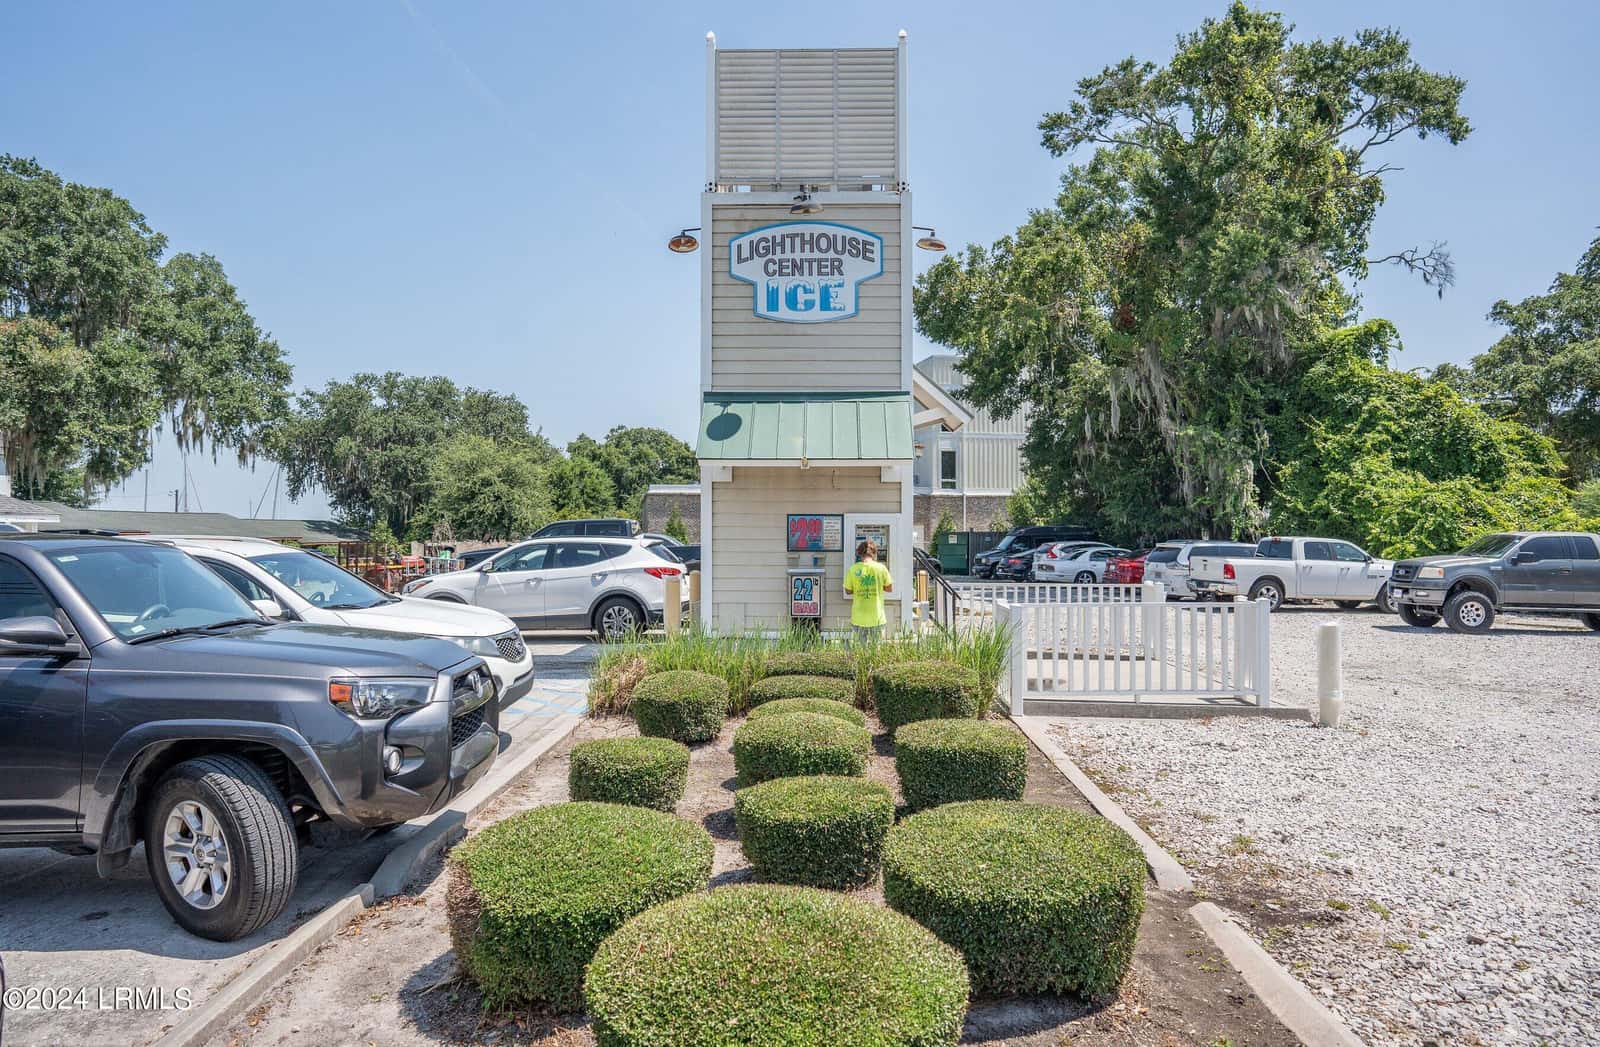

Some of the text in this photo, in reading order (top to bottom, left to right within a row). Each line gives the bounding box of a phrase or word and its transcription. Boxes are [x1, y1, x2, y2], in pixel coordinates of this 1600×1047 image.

[736, 233, 875, 264] LIGHTHOUSE
[763, 257, 845, 277] CENTER
[766, 278, 845, 312] ICE
